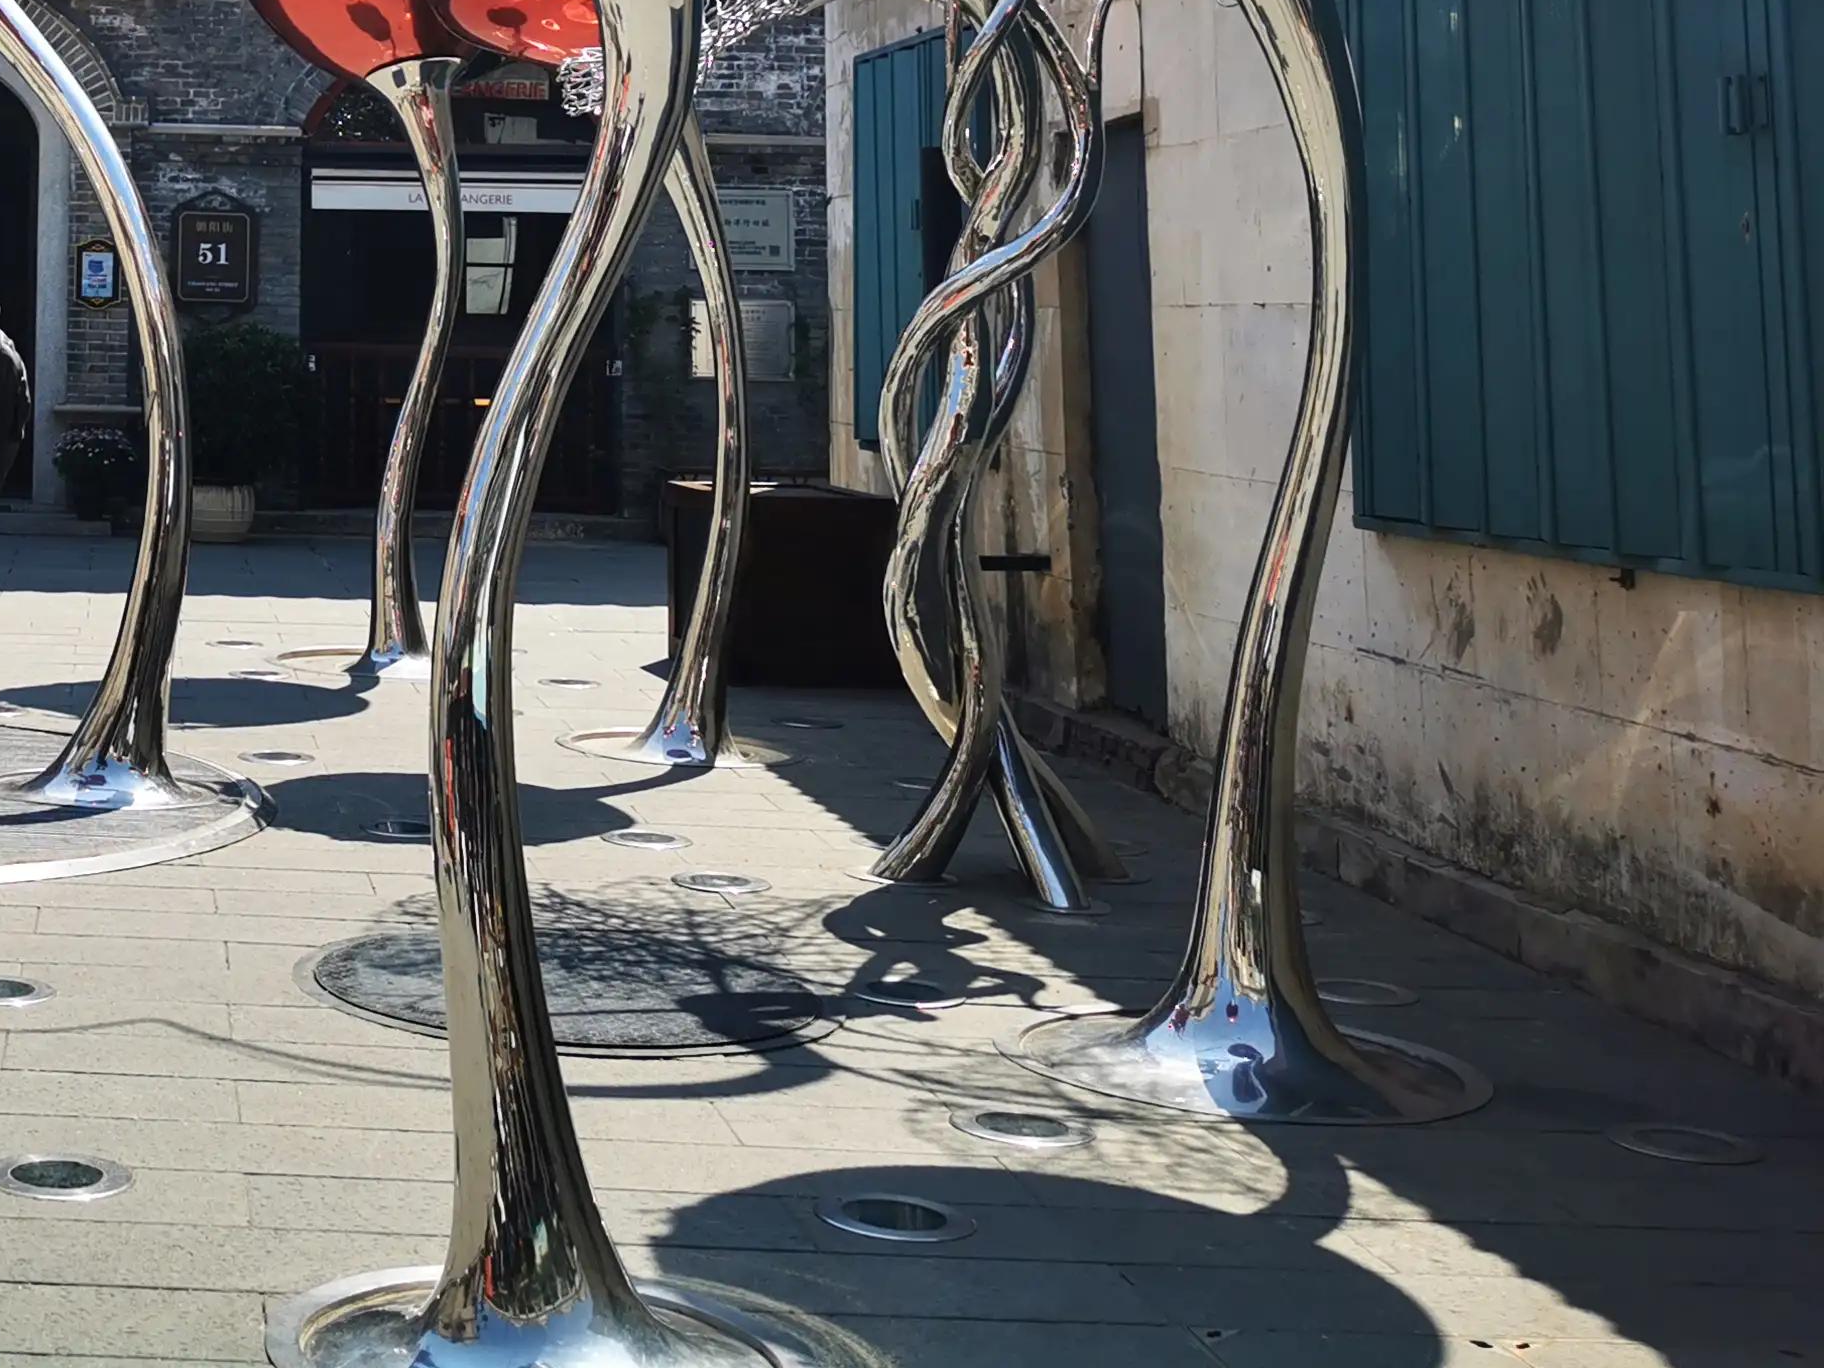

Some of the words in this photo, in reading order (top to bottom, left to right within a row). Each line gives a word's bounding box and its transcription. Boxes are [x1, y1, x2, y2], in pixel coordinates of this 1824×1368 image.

[461, 81, 546, 100] ANGERIE
[408, 192, 425, 204] LA
[461, 193, 513, 205] ANGERIE
[197, 242, 230, 265] 51
